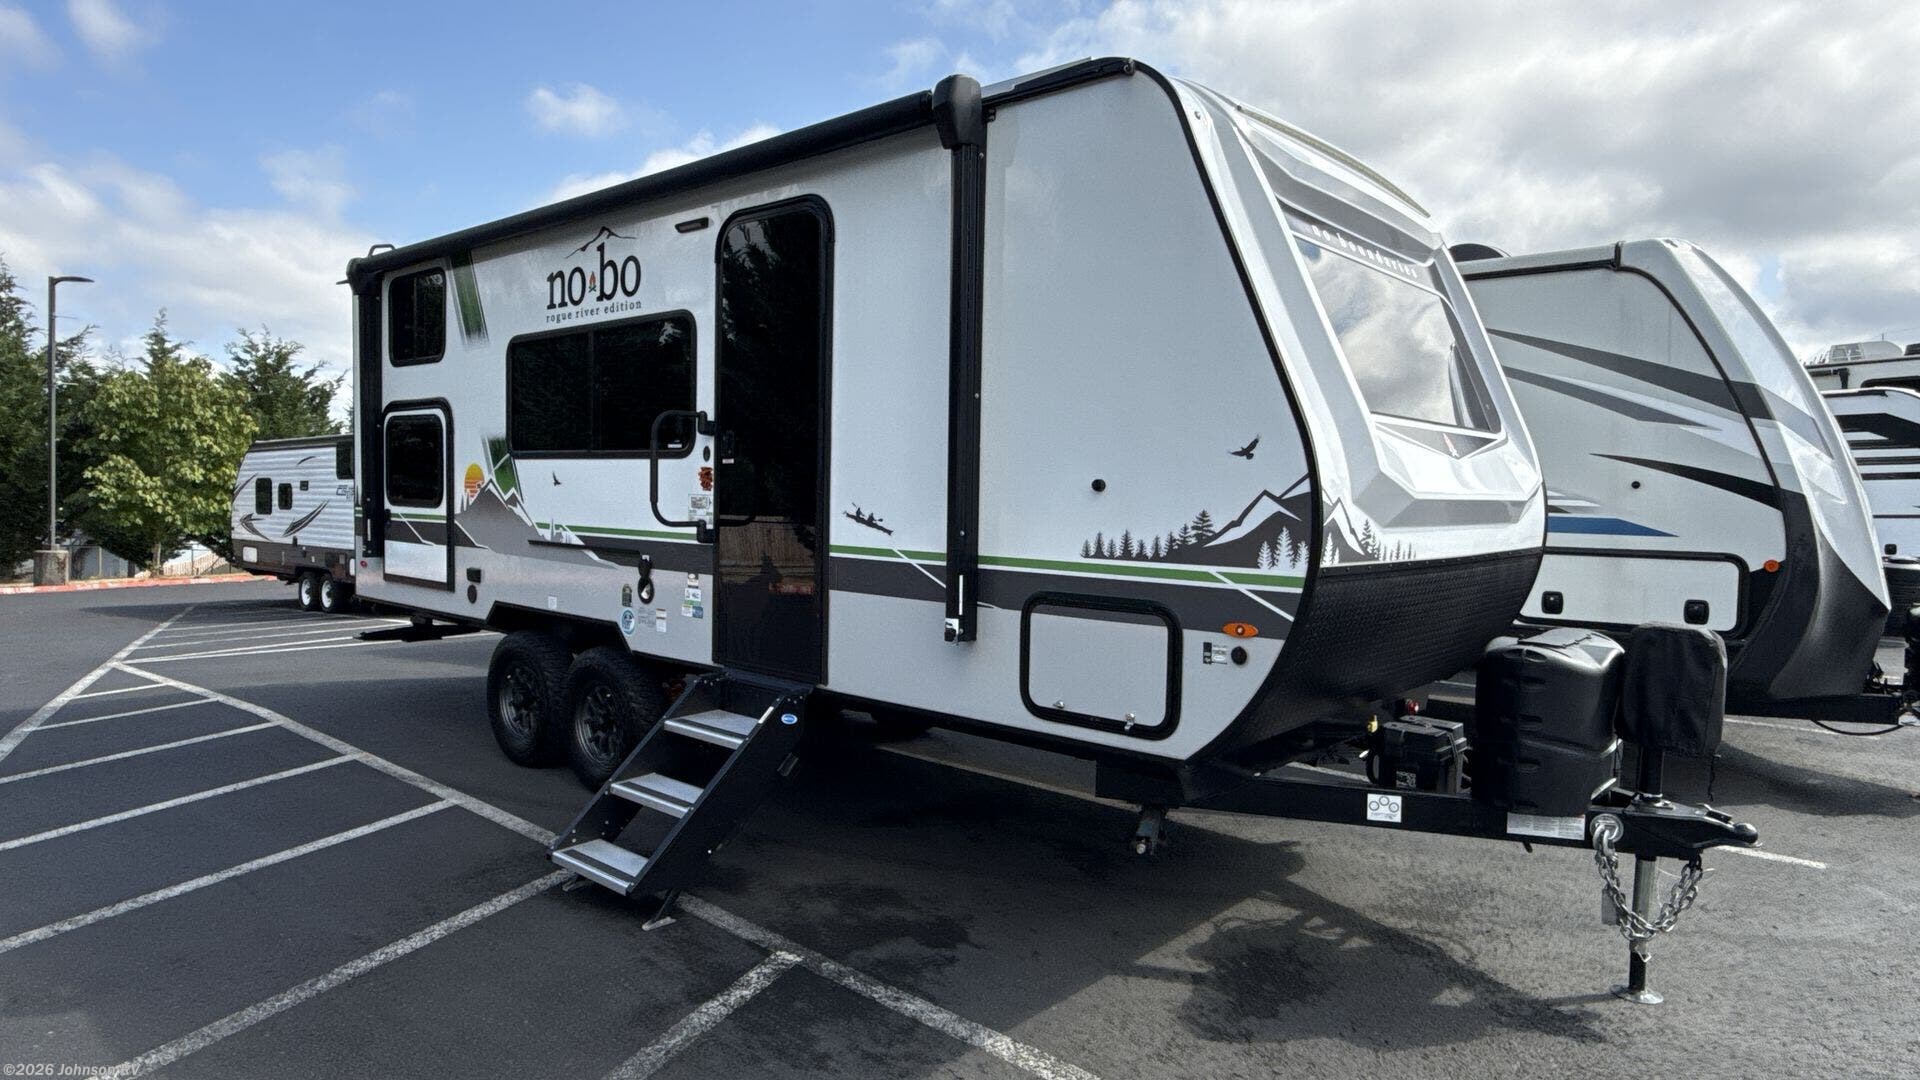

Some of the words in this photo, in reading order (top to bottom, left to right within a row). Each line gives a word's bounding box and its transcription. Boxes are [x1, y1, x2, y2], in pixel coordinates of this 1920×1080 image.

[1311, 224, 1331, 241] no
[1336, 232, 1418, 278] boundaries
[546, 312, 572, 324] rogue
[575, 307, 600, 318] river
[603, 300, 642, 314] edition
